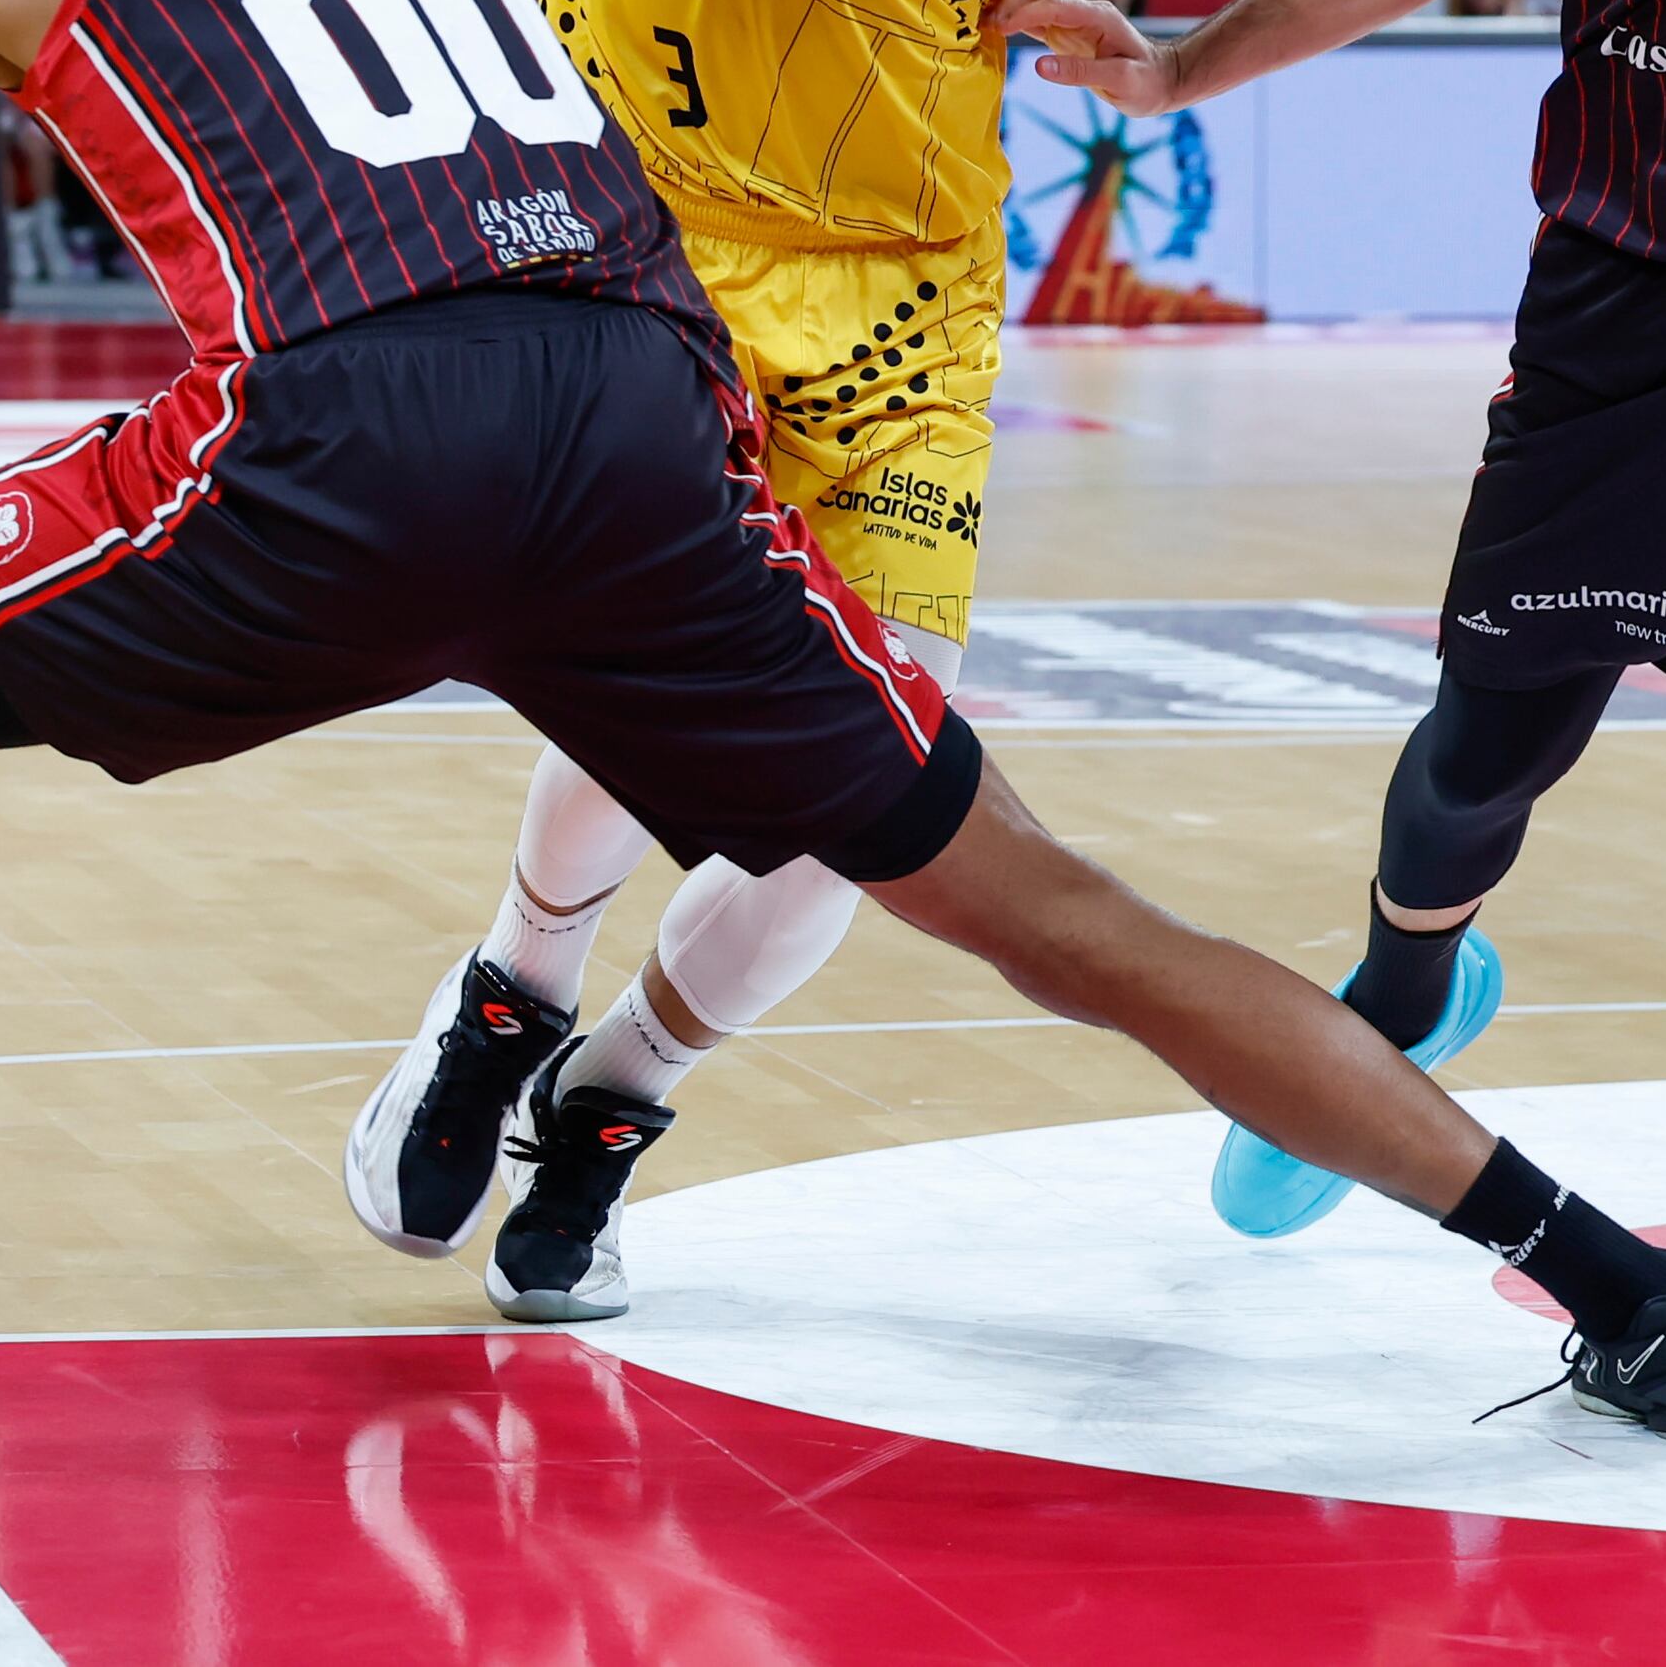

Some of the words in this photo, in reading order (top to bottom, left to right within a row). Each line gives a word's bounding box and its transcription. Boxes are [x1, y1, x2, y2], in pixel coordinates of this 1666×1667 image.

[653, 25, 709, 129] 3
[482, 212, 591, 246] SABOR
[880, 466, 948, 507] Islas
[863, 521, 902, 540] LATITUD
[904, 531, 916, 544] DE
[918, 535, 938, 551] VIDA
[1457, 613, 1510, 637] MERCURY
[1614, 619, 1651, 641] new
